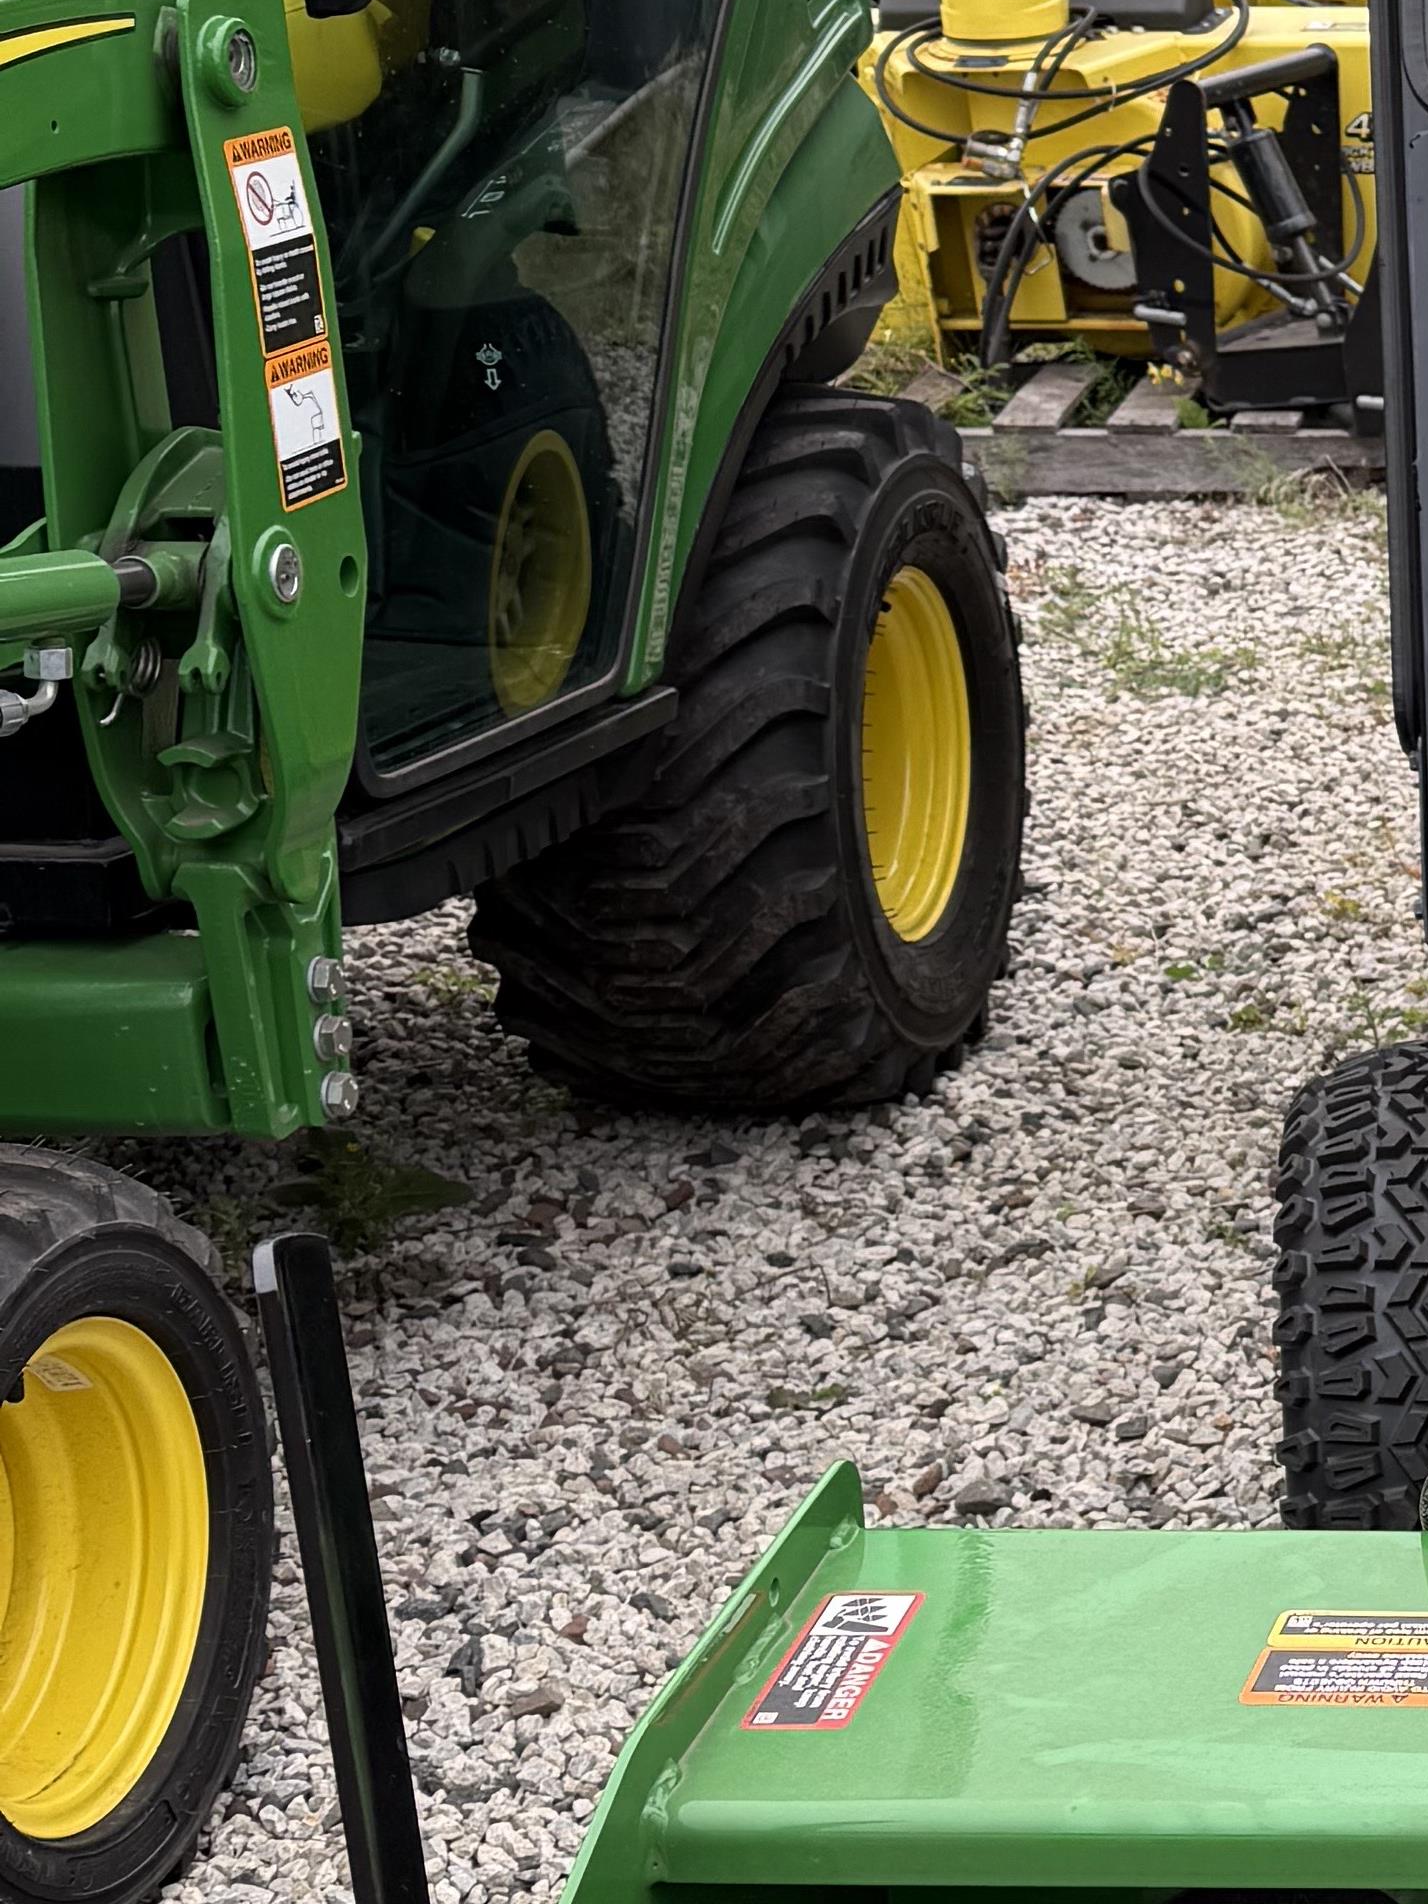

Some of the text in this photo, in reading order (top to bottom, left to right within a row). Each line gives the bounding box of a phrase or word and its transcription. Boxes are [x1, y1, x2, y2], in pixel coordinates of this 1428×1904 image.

[239, 130, 292, 159] WARNING
[278, 353, 329, 384] WARNING
[820, 1652, 884, 1720] DANGER
[1276, 1694, 1386, 1703] WARNING
